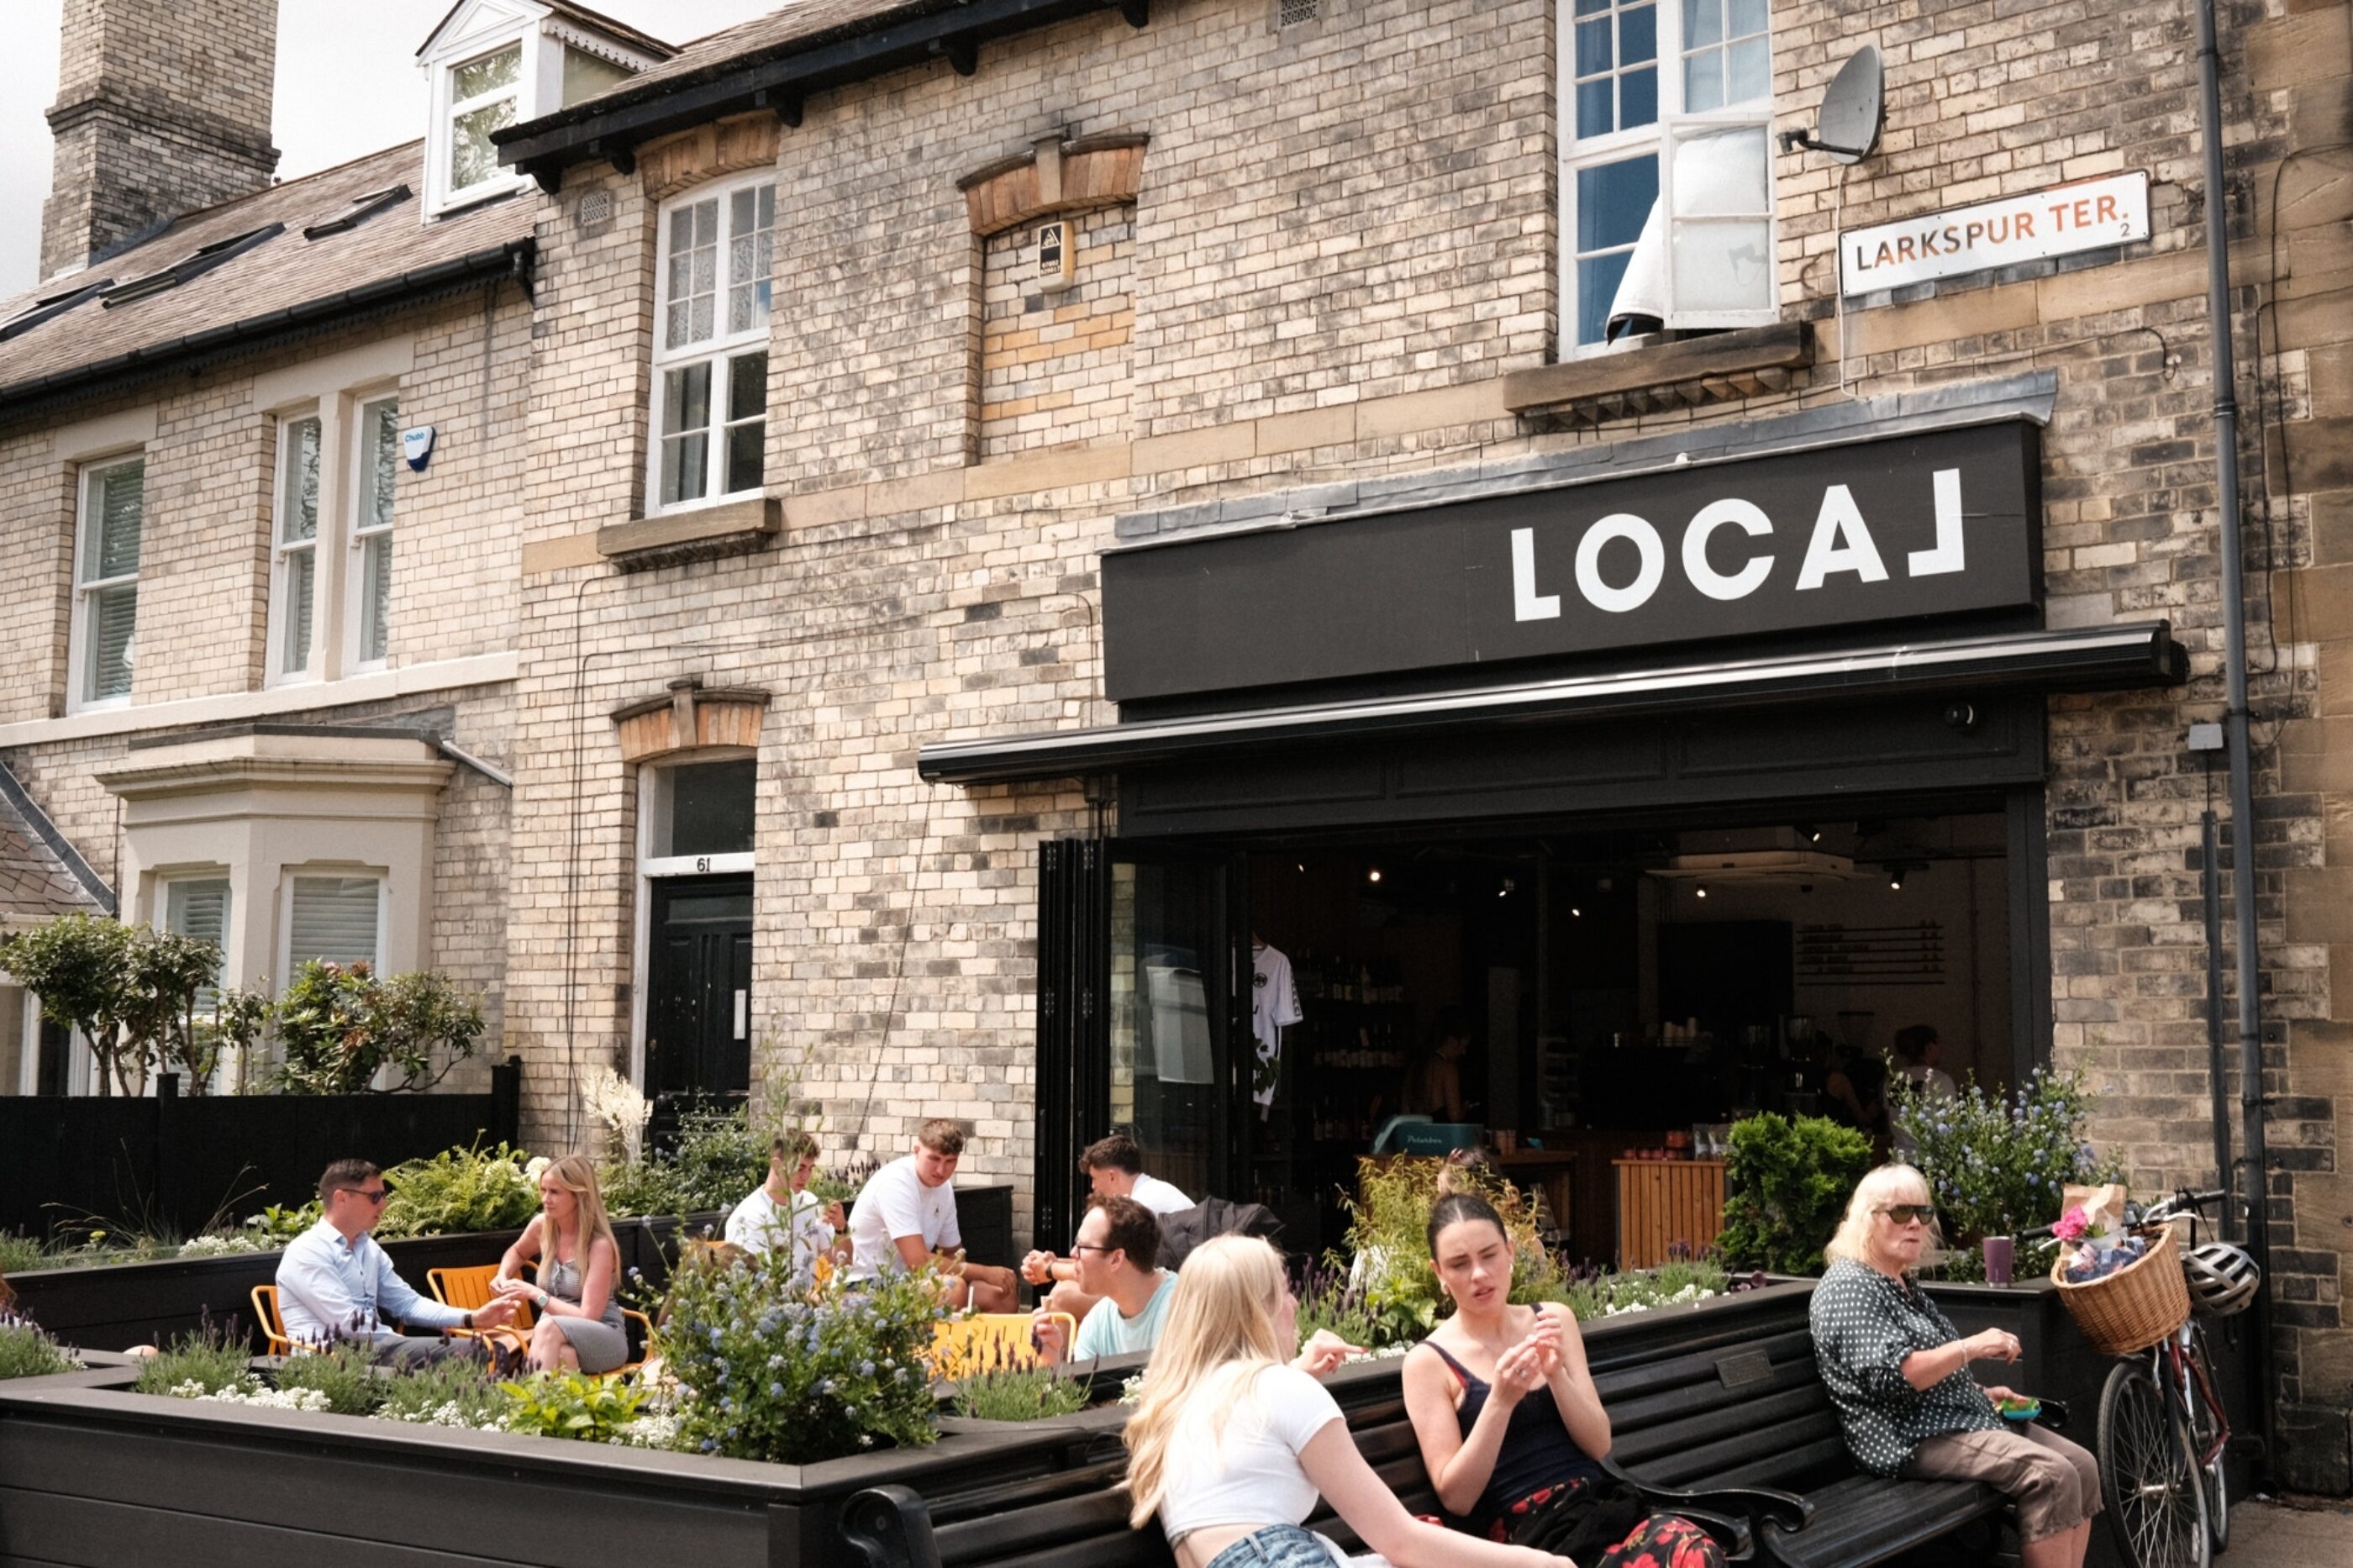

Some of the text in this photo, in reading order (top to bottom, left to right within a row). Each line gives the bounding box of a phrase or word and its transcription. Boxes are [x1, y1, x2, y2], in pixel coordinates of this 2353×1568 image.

[1856, 195, 2129, 271] LARKSPUR TER.
[2119, 223, 2131, 238] 2
[405, 432, 424, 442] Chubb
[1510, 467, 1966, 622] LOCAL
[697, 857, 711, 872] 61
